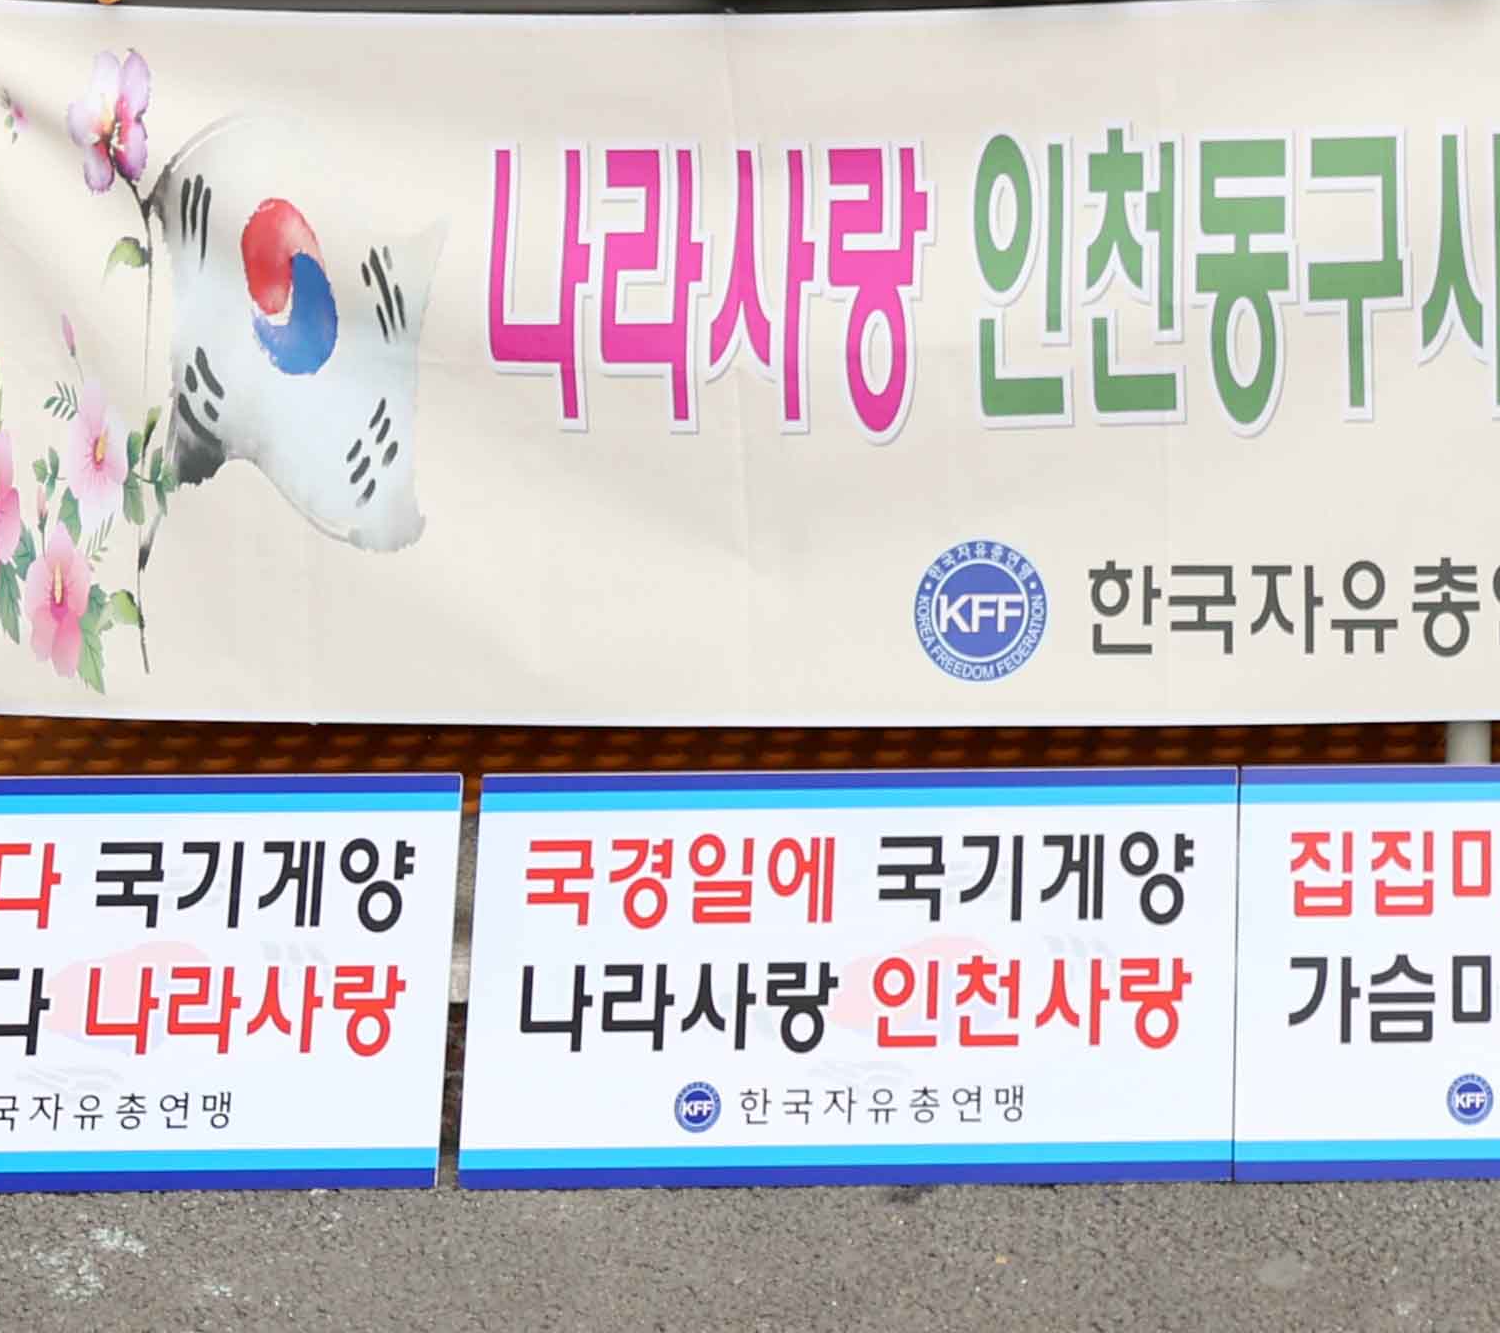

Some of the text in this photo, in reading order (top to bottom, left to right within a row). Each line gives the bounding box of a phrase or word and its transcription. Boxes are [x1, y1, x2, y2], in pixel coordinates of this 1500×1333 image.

[489, 148, 928, 433] 나라사랑
[916, 593, 1045, 680] KOREA FREEDOM FEDERATION
[938, 593, 1023, 634] KFF
[96, 838, 415, 932] 국기게양
[526, 832, 1194, 929] 국경일에 국기게양
[86, 966, 406, 1056] 나라사랑
[520, 956, 1191, 1053] 나라사랑 인천사랑
[680, 1099, 714, 1115] KFF
[742, 1086, 1023, 1124] 한국자유총연맹
[1452, 1092, 1488, 1108] KFF
